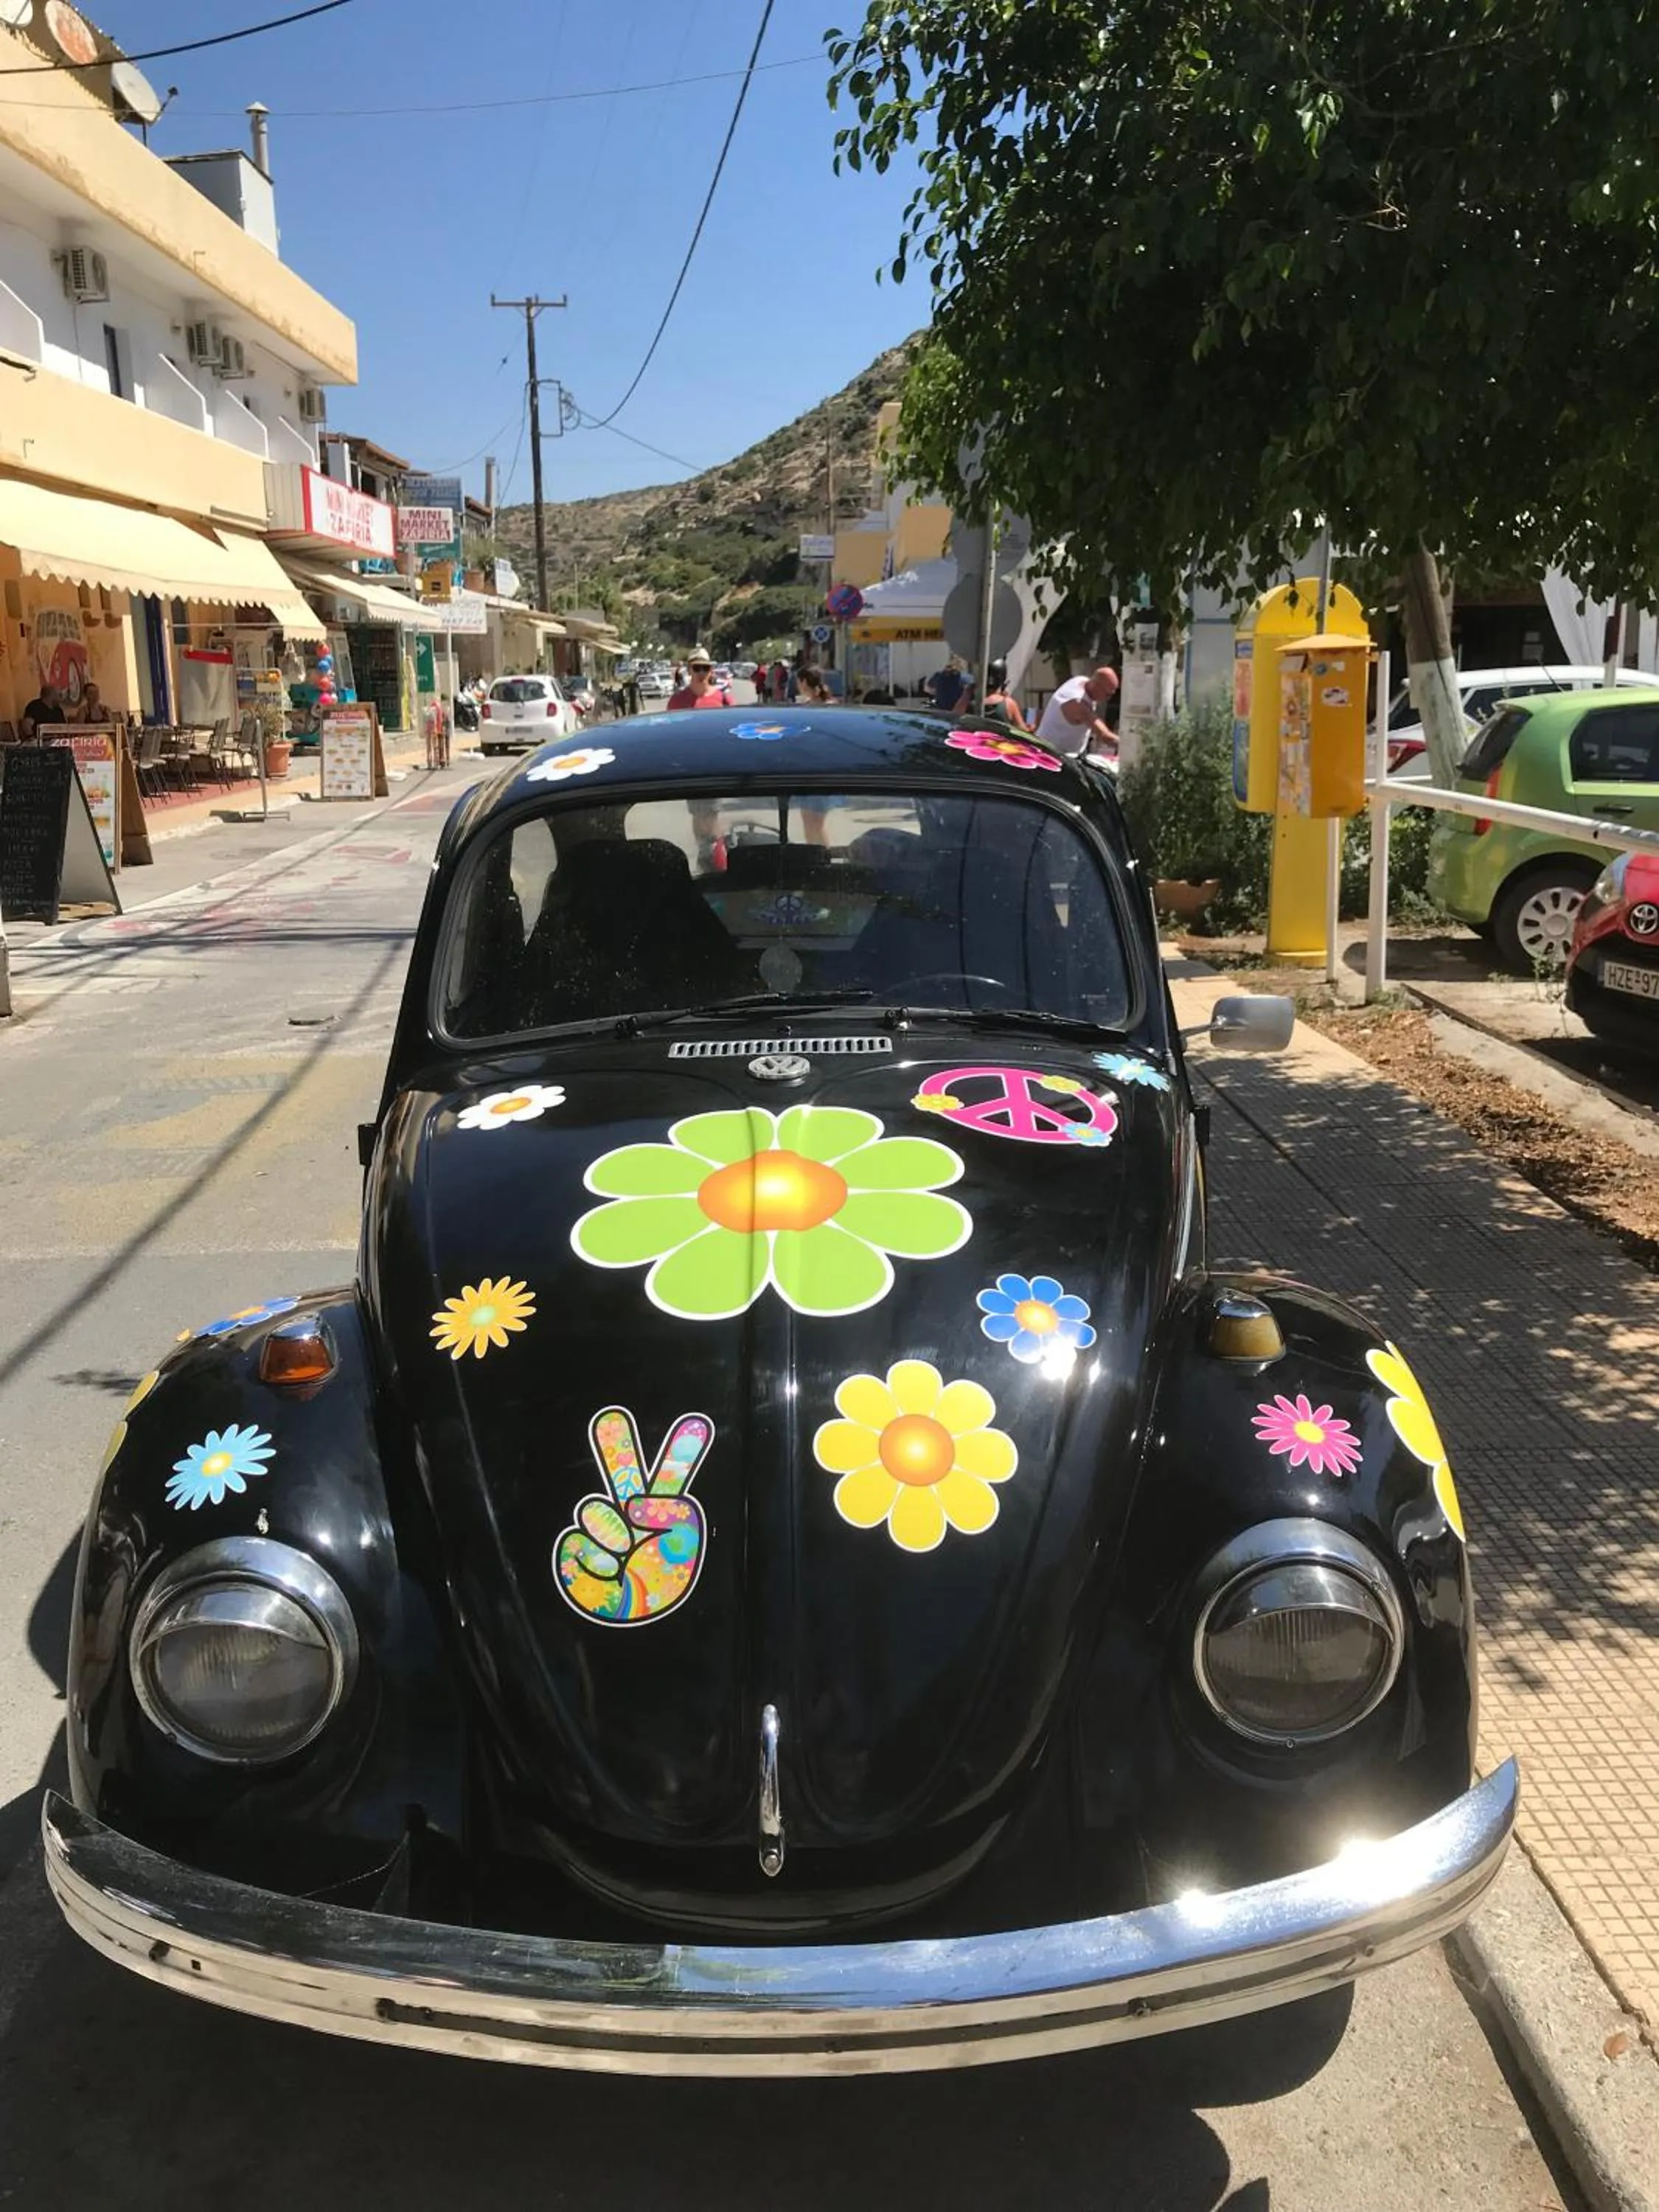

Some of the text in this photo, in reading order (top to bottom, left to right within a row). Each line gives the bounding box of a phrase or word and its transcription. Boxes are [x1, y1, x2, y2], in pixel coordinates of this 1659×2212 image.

[409, 509, 442, 519] MINI
[400, 520, 449, 529] MARKET
[896, 629, 921, 639] ATM
